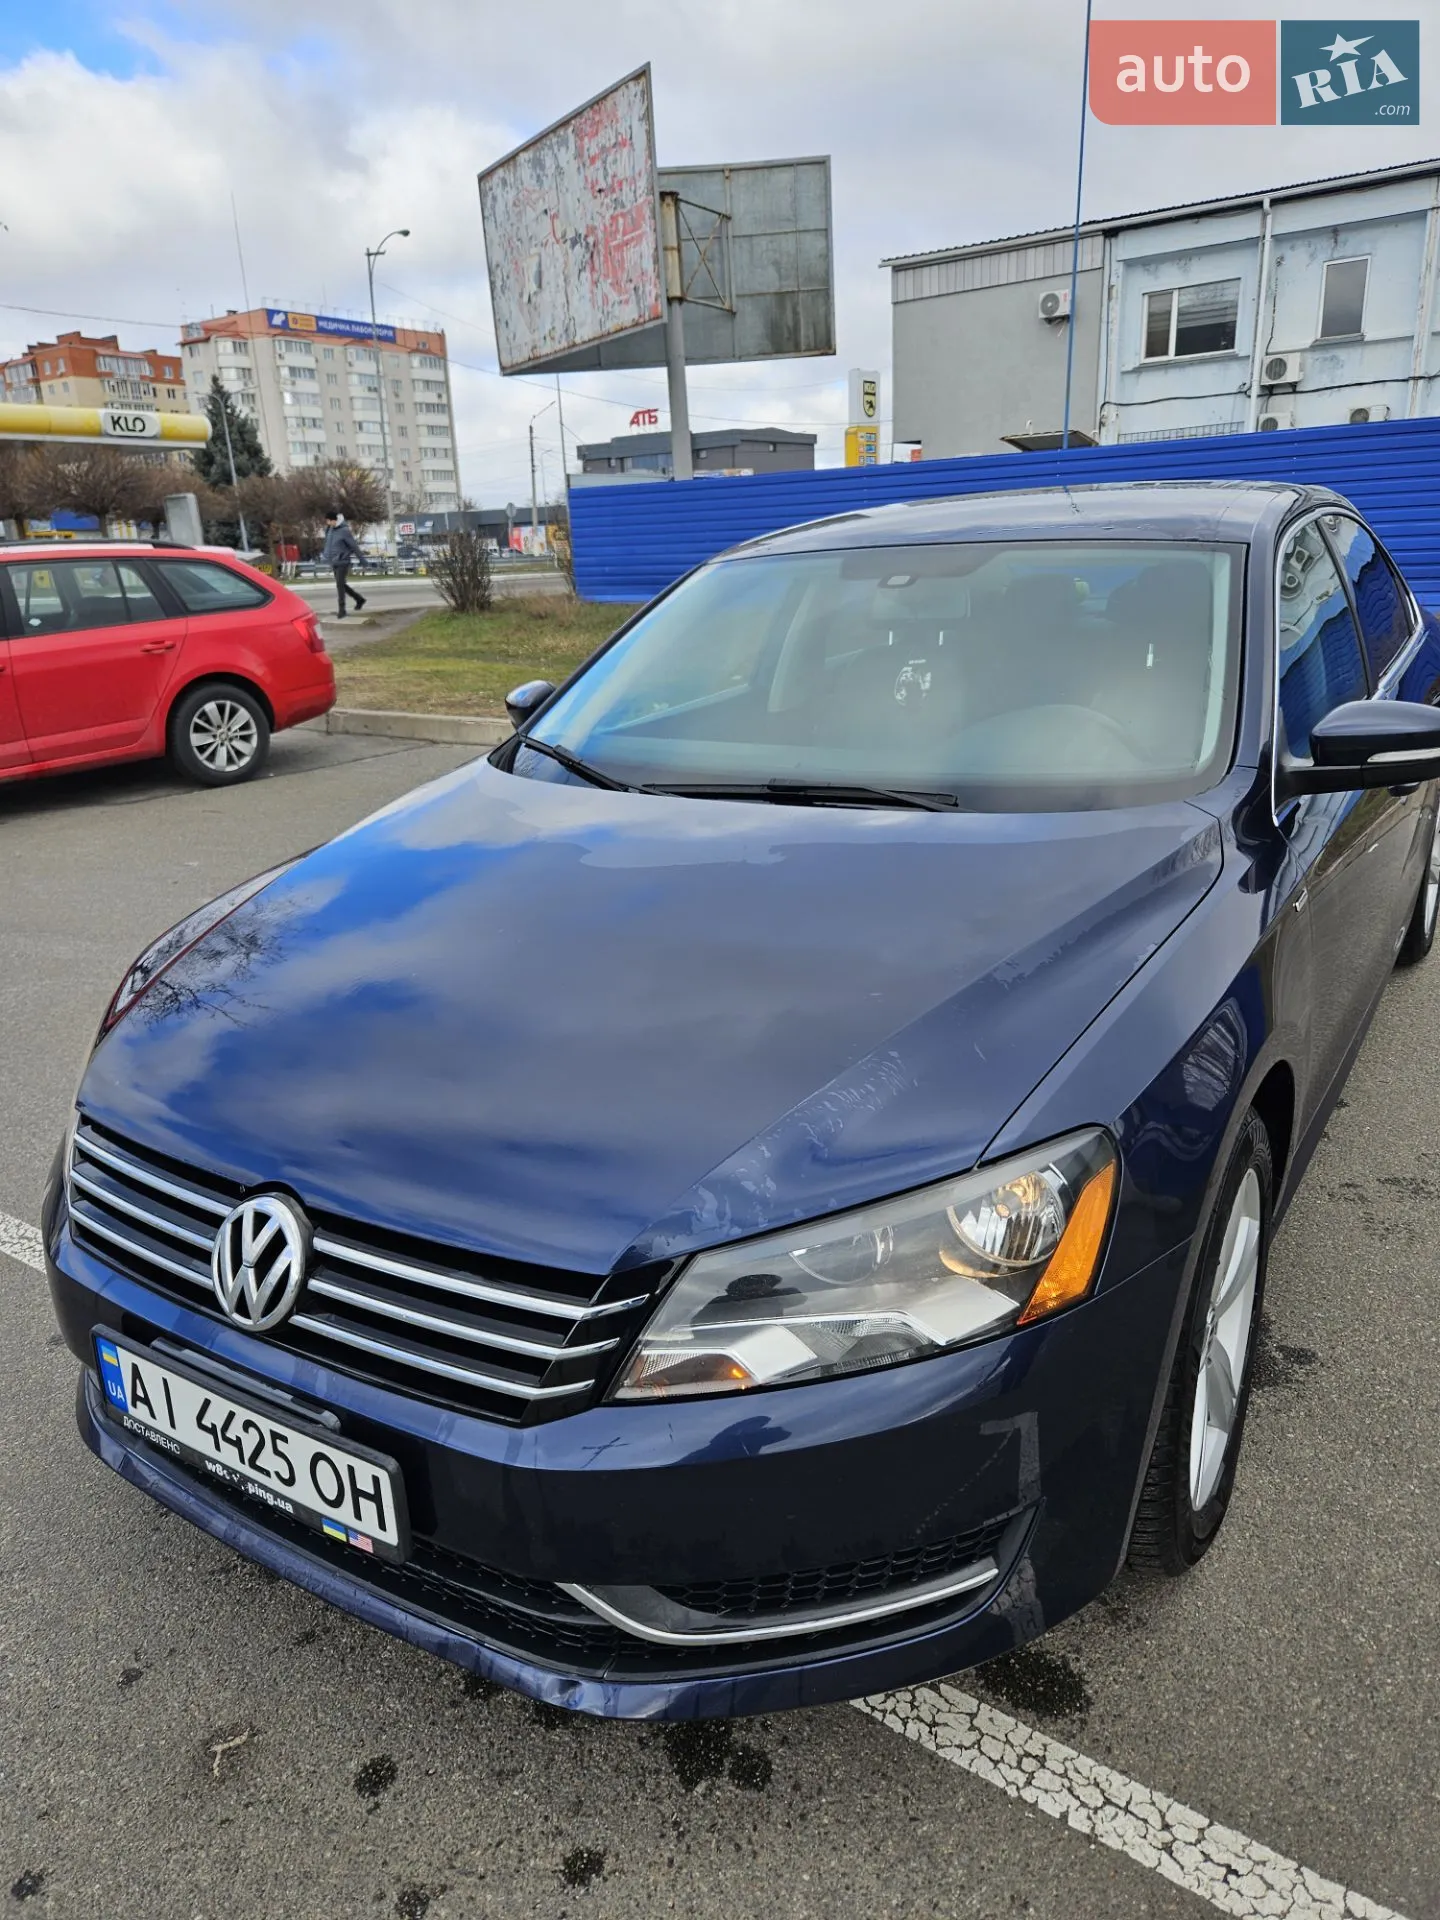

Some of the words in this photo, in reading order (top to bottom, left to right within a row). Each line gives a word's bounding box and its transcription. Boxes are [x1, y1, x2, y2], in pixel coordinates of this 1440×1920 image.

[111, 415, 146, 433] KLO
[107, 1380, 126, 1403] UA
[131, 1362, 177, 1431] AI
[195, 1397, 297, 1488] 4425
[309, 1451, 387, 1532] OH
